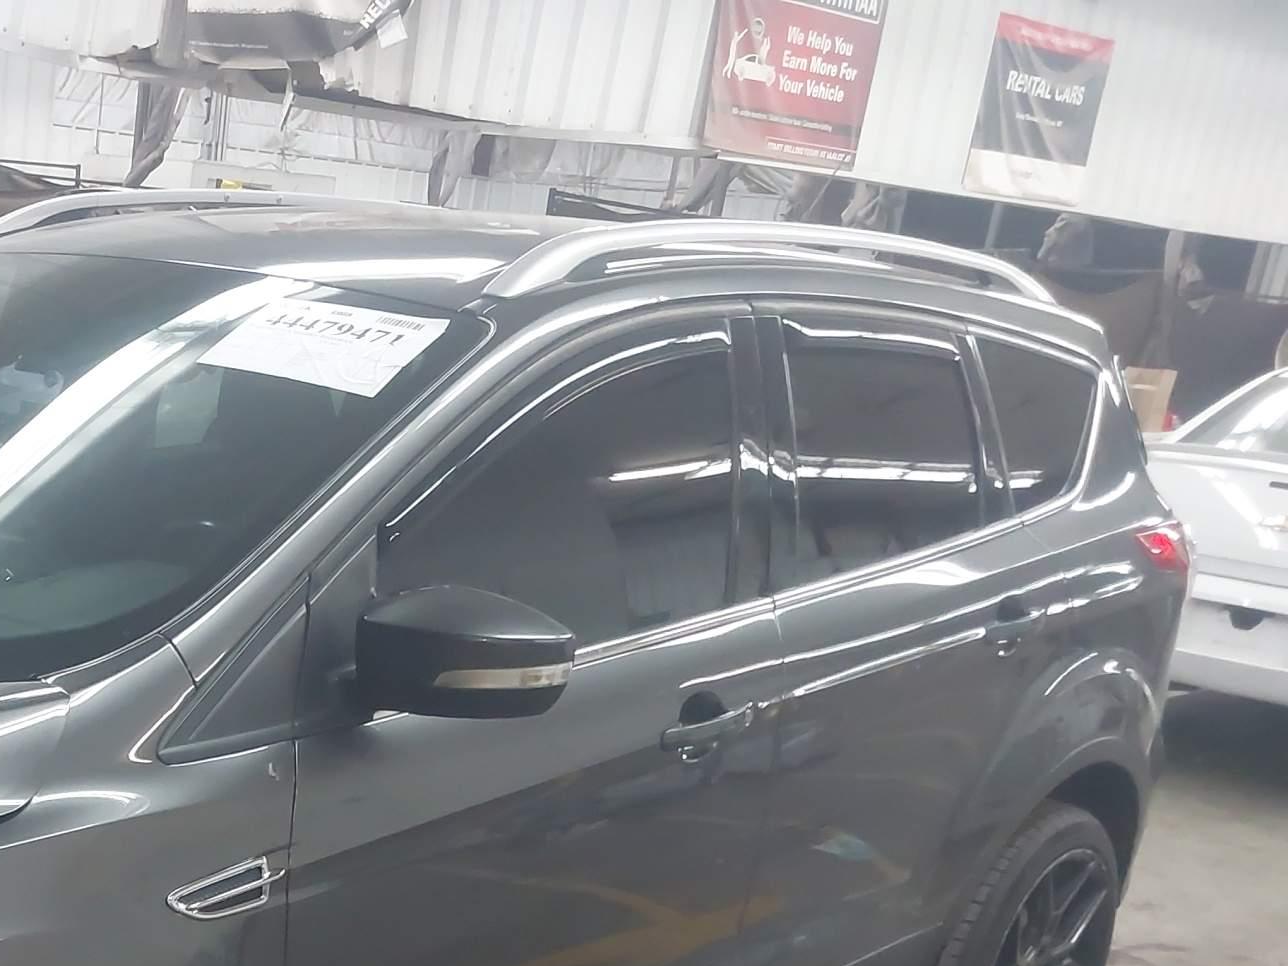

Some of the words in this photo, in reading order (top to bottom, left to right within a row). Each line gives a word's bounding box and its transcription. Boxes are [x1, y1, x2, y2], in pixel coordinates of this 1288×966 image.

[787, 25, 805, 46] We
[806, 30, 832, 55] Help
[834, 36, 853, 57] You
[782, 49, 808, 72] Earn
[809, 55, 838, 77] More
[839, 62, 858, 81] For
[778, 73, 804, 96] Your
[806, 79, 844, 103] Vehicle
[1005, 70, 1052, 100] RENTAL
[1054, 84, 1086, 106] CARS
[265, 313, 405, 346] 44479471
